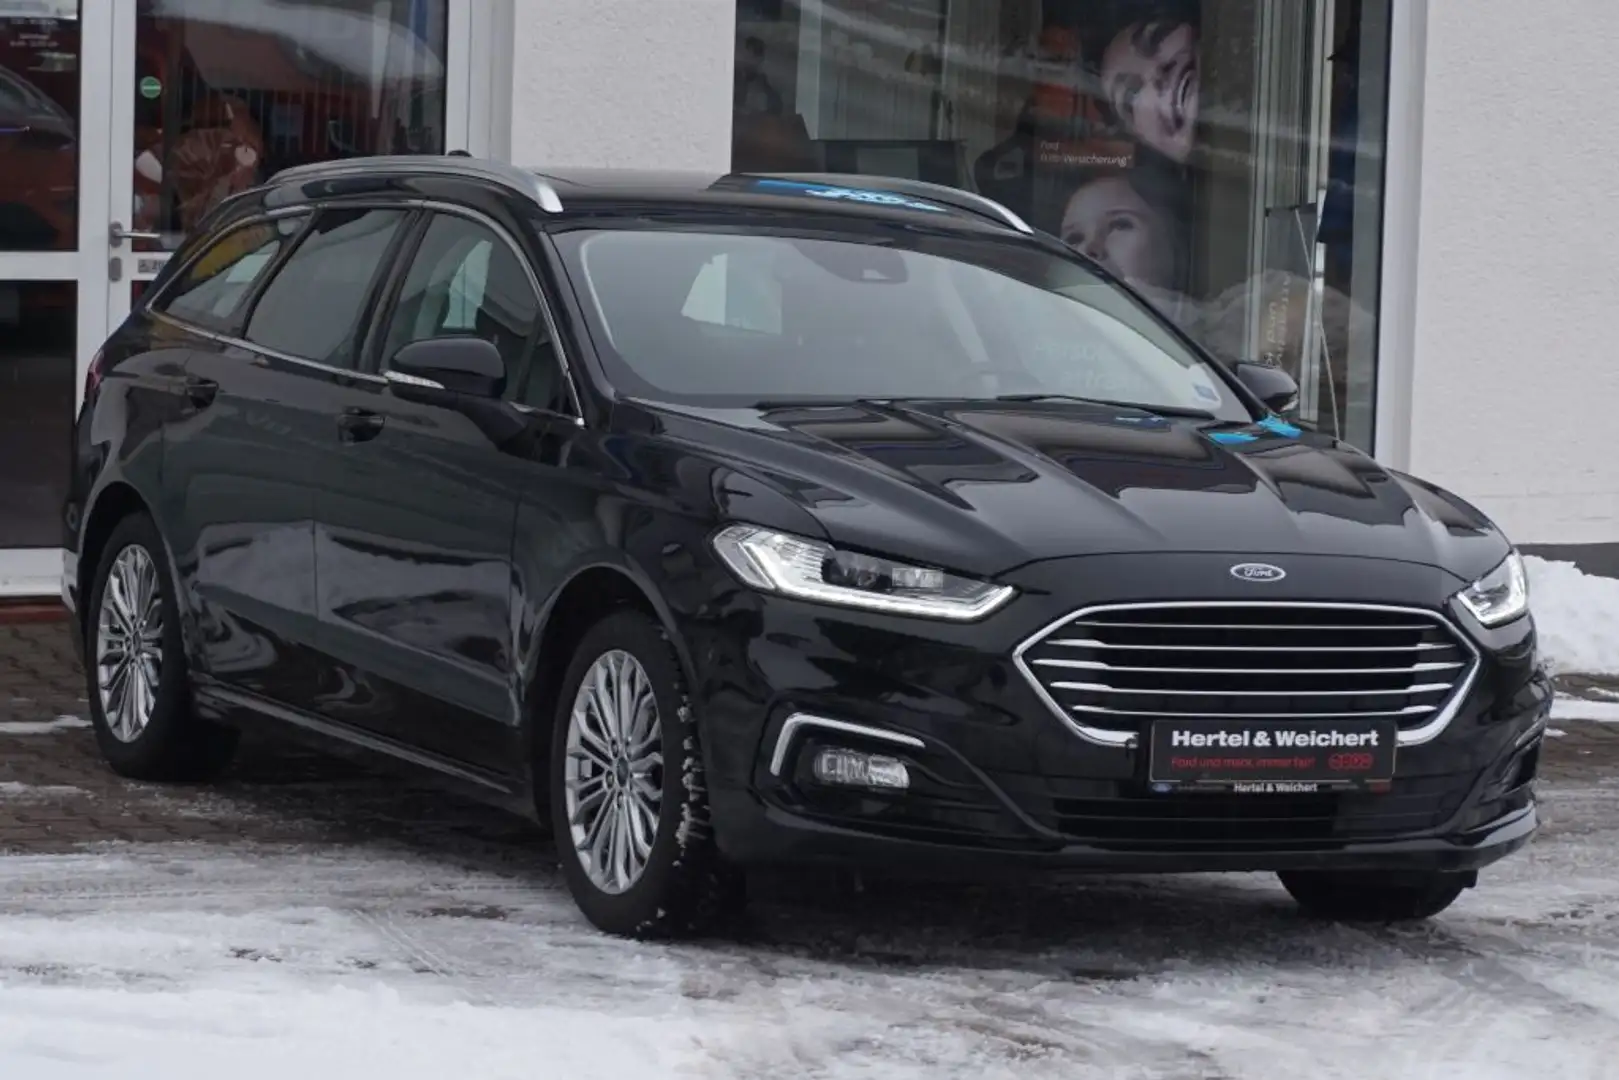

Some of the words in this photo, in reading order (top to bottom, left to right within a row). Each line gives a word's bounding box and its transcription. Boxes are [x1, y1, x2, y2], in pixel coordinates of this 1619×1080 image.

[1243, 567, 1273, 577] Ford
[1171, 730, 1249, 747] Hertel
[1253, 730, 1271, 747] &
[1275, 730, 1378, 747] Weichert
[1234, 783, 1264, 792] Hertel
[1266, 783, 1274, 792] &
[1276, 783, 1317, 792] Weichert
